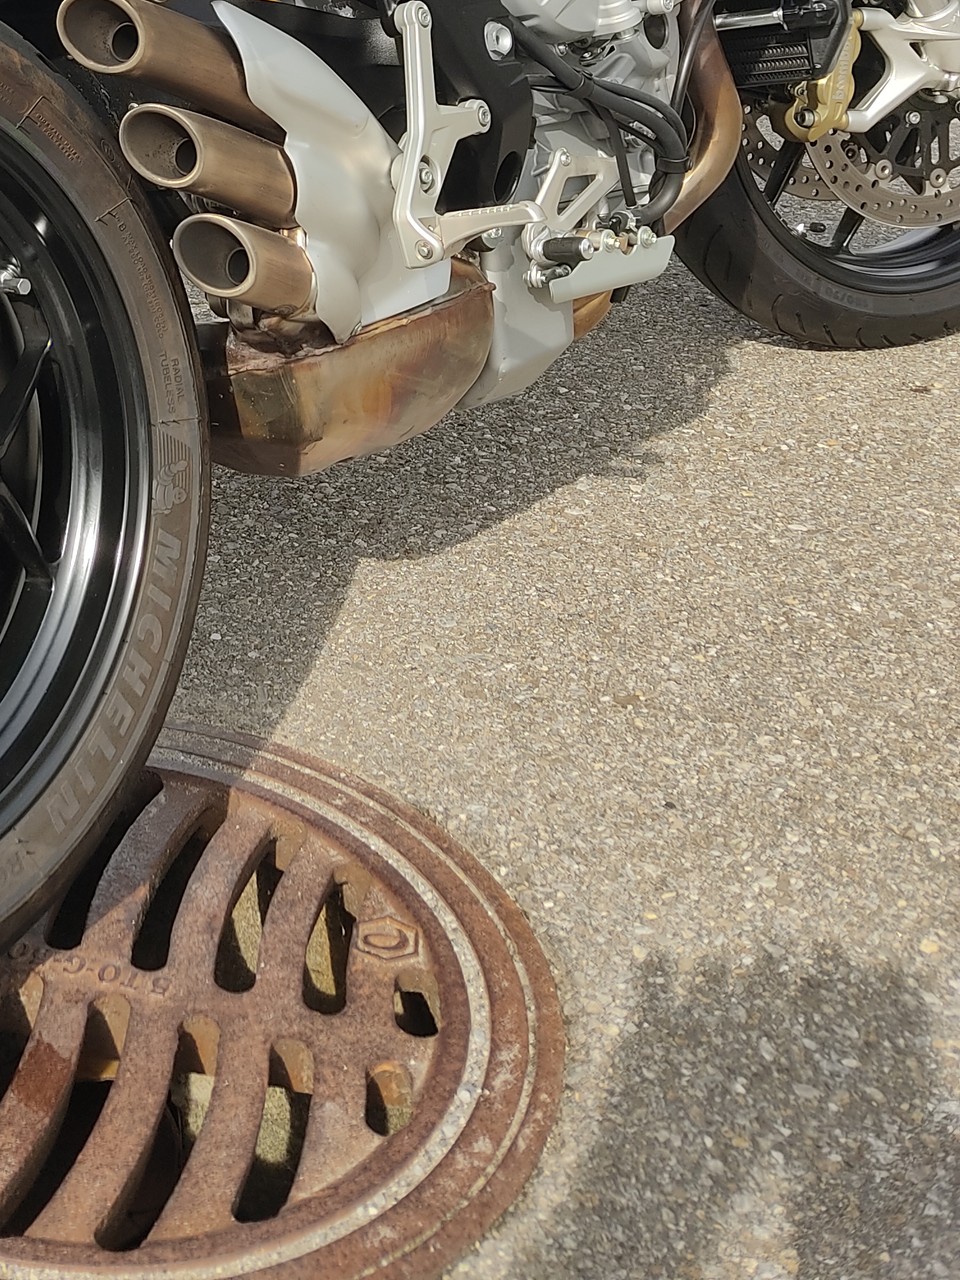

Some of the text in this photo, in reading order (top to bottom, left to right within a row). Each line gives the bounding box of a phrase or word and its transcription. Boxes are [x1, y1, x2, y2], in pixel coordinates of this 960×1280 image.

[157, 348, 176, 415] TUBELESS
[170, 356, 185, 403] RADIAL
[38, 526, 186, 834] MICHELIN
